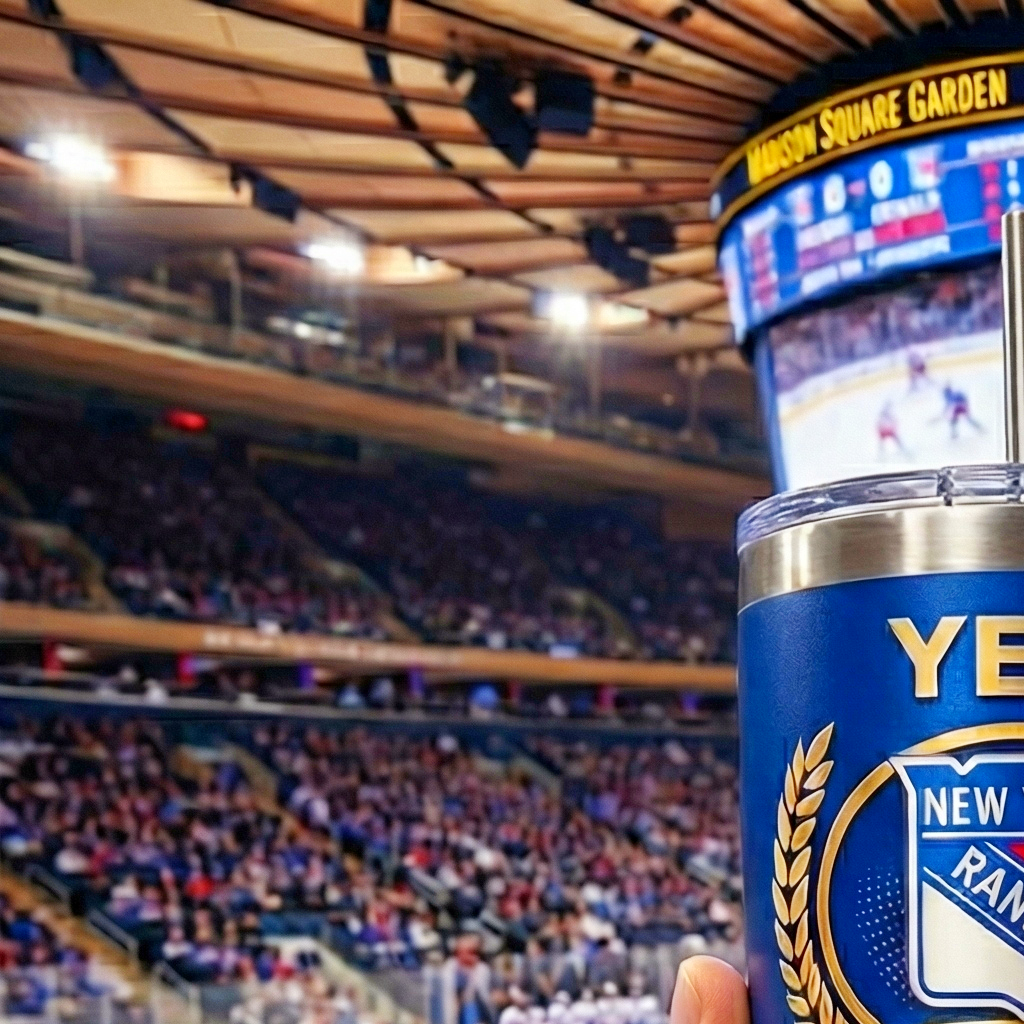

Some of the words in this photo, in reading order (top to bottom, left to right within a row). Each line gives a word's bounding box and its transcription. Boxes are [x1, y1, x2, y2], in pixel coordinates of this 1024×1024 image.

[820, 89, 902, 150] SQUARE
[908, 68, 1007, 123] GARDEN
[922, 786, 1008, 826] NEW
